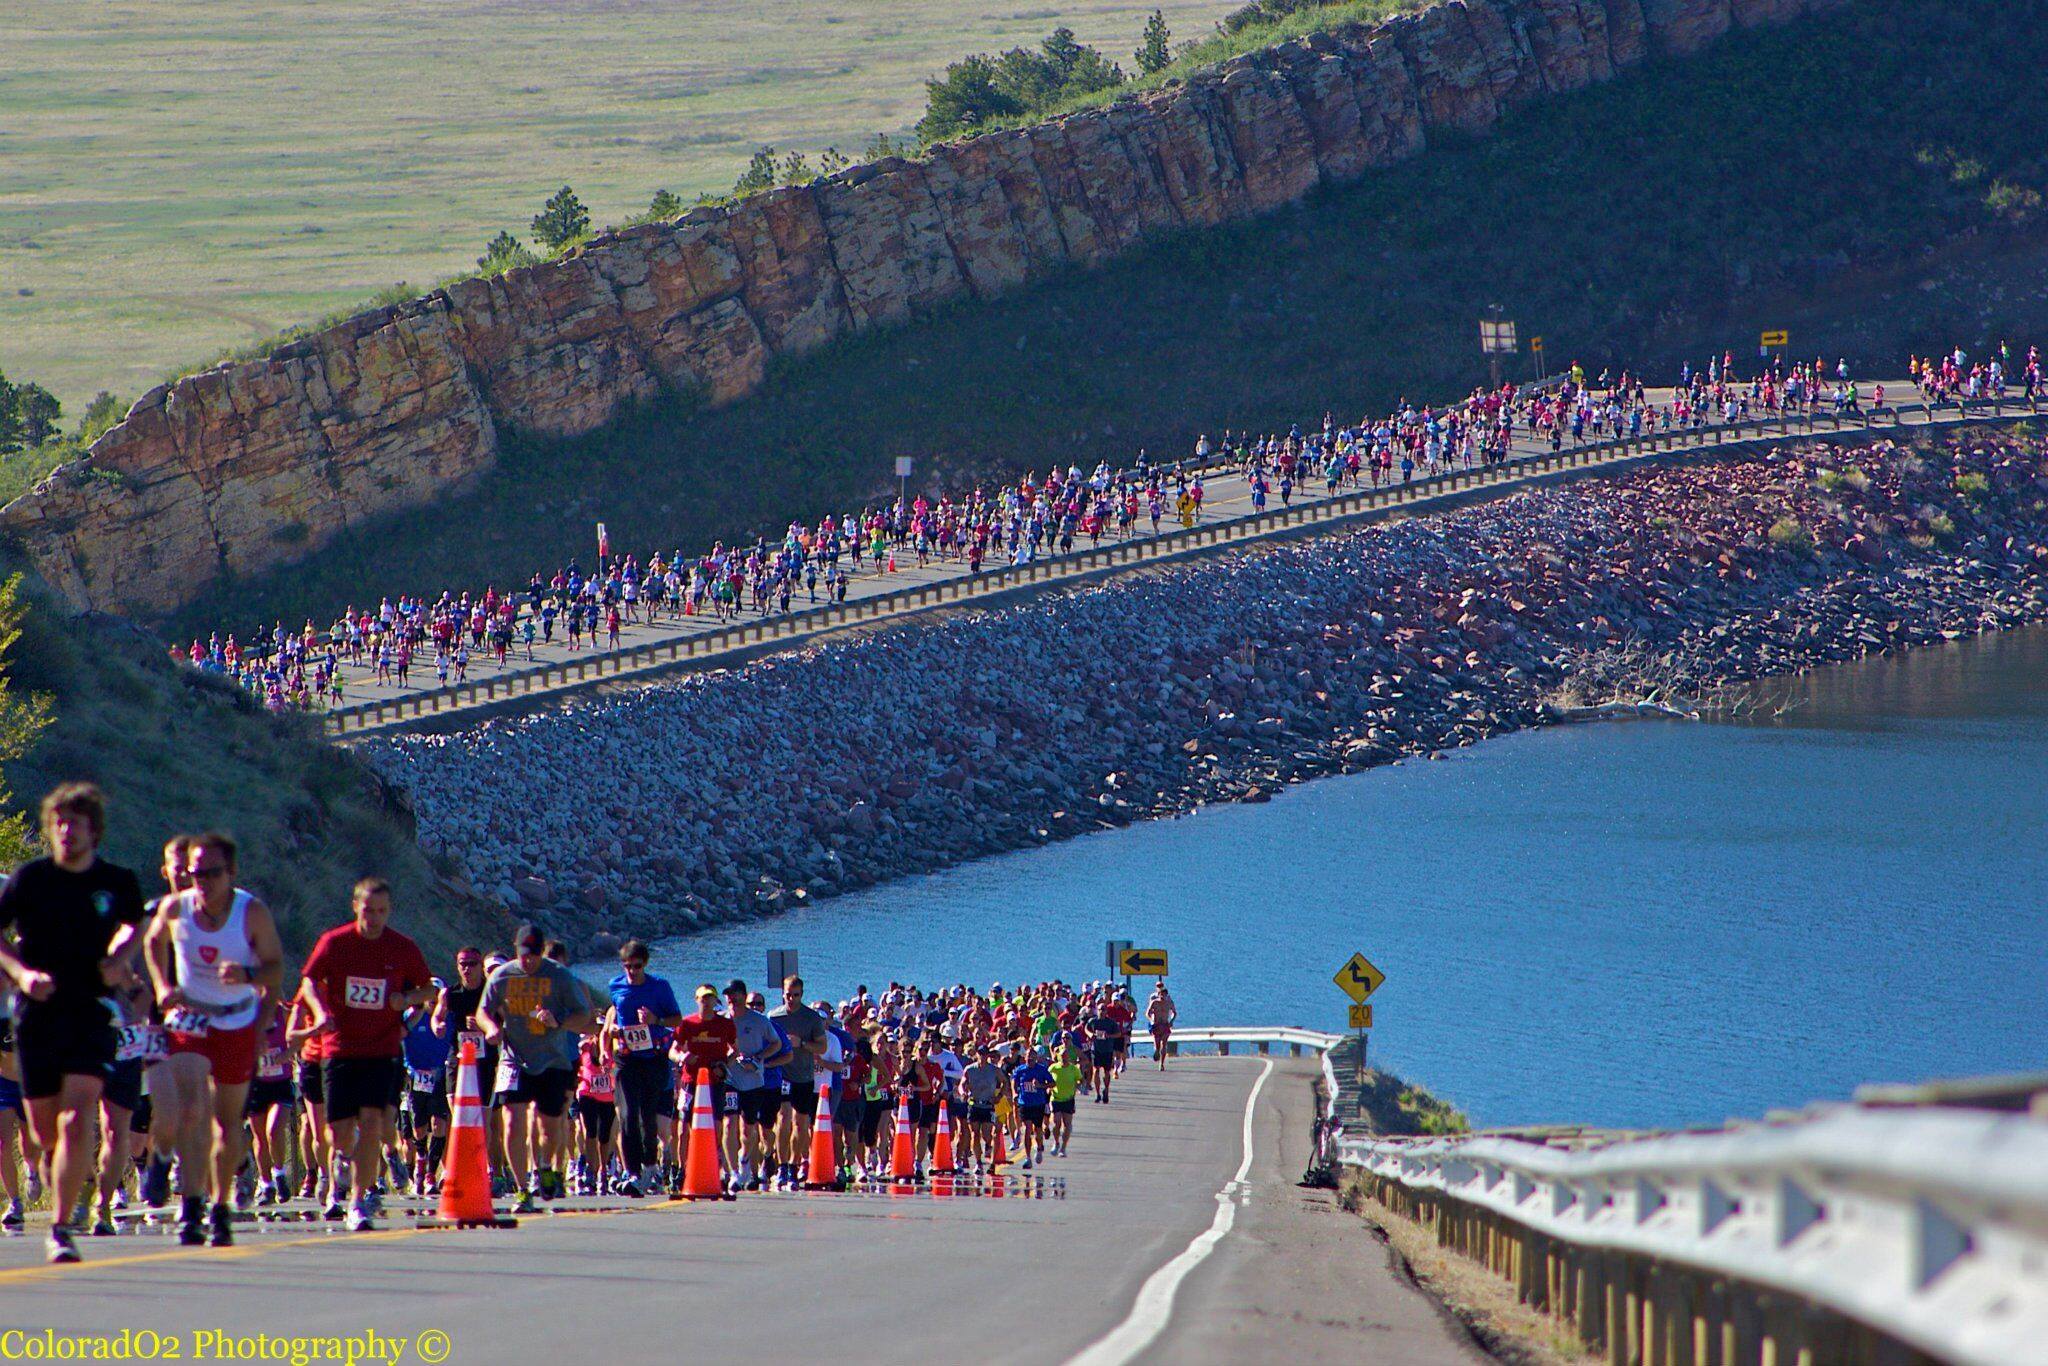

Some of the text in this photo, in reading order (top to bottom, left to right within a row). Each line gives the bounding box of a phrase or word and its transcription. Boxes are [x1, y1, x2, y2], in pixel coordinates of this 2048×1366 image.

[350, 985, 379, 1004] 223
[1351, 1006, 1370, 1020] 20
[627, 1029, 647, 1043] 438
[418, 1074, 434, 1085] 154
